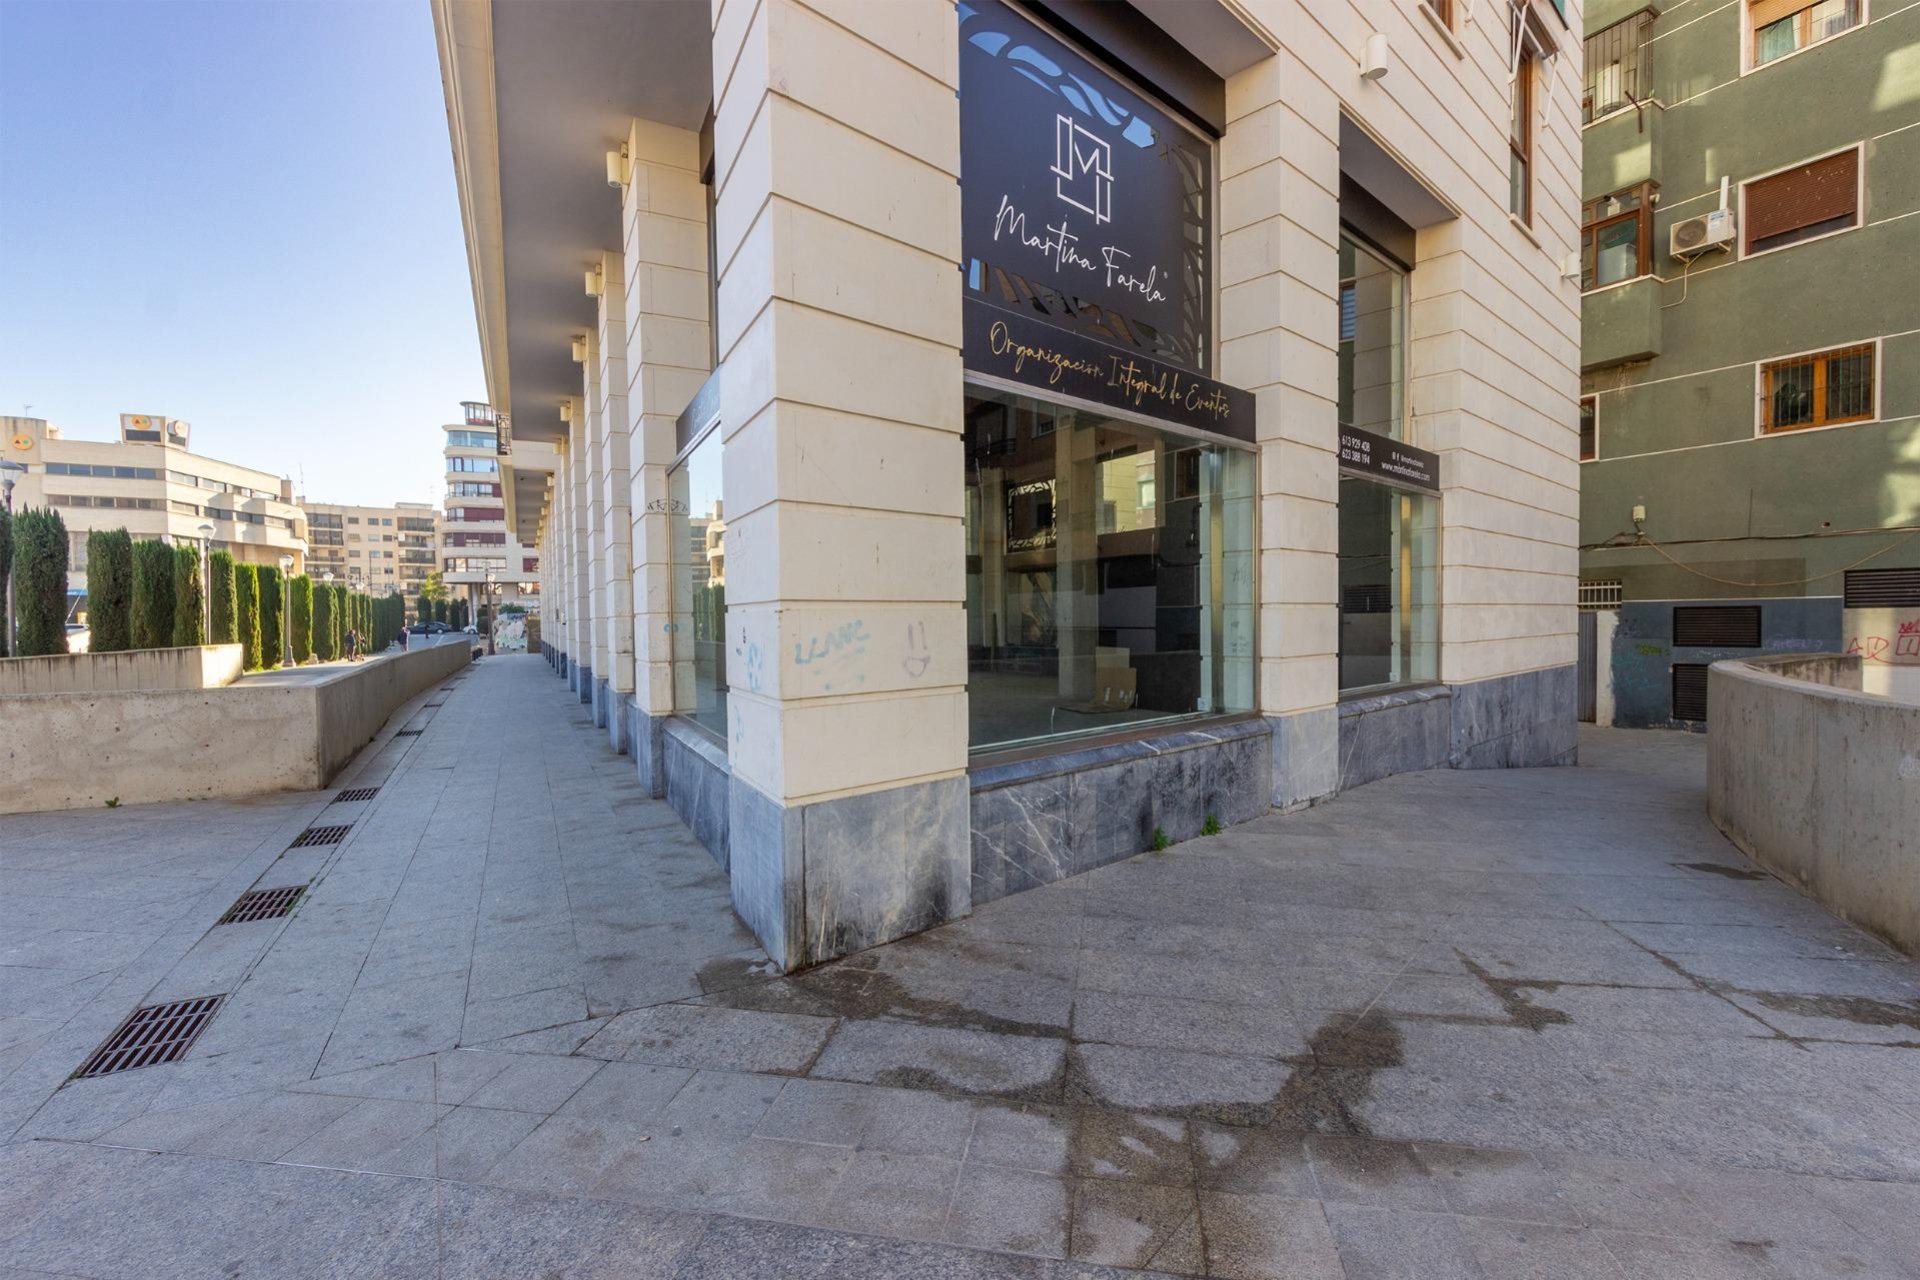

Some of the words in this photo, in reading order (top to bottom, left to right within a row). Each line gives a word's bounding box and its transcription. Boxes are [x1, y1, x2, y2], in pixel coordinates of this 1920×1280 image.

[993, 194, 1096, 272] Martina
[1105, 354, 1168, 406] Integral
[1169, 373, 1183, 405] de
[1185, 383, 1230, 421] Eventos
[1341, 434, 1351, 447] 613
[1351, 437, 1361, 449] 929
[1341, 448, 1351, 460] 623
[1361, 453, 1371, 465] 194
